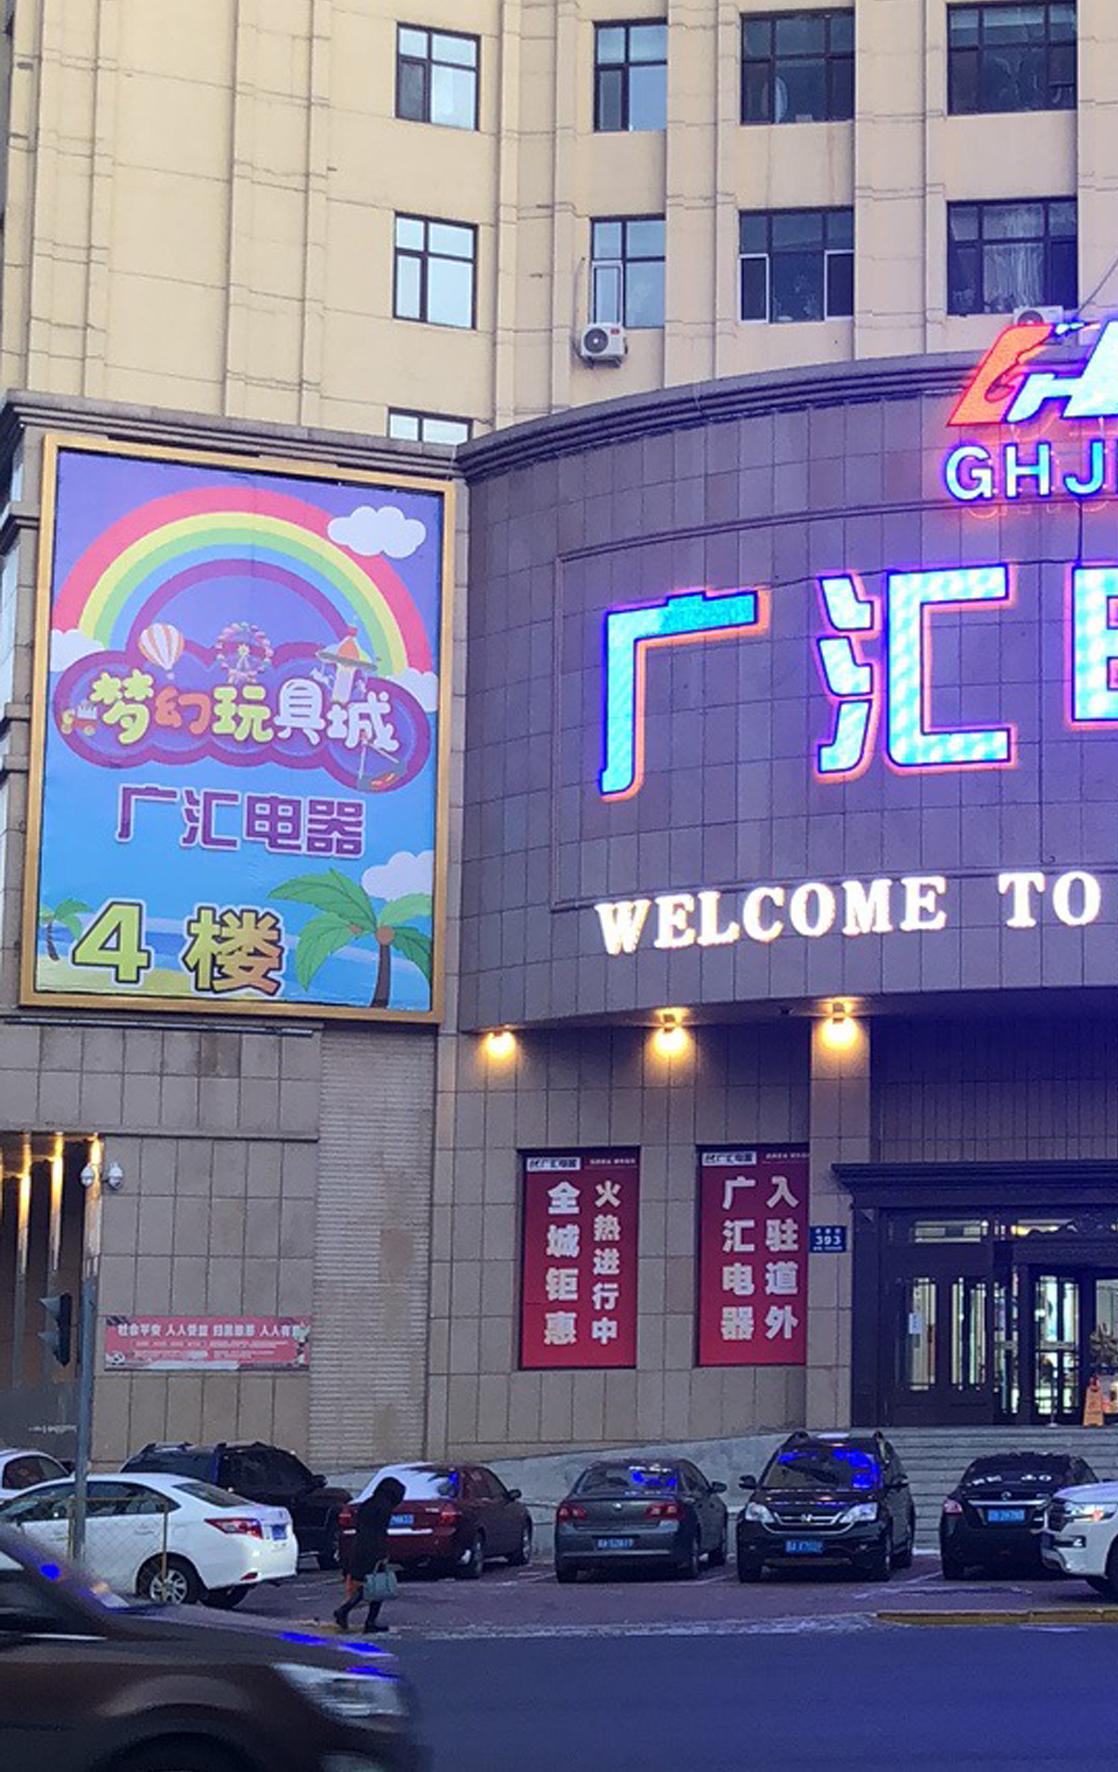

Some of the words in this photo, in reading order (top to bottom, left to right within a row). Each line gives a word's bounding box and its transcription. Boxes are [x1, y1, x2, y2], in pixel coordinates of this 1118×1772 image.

[89, 667, 400, 752] 梦幻玩具城
[116, 784, 367, 859] 广汇电器
[594, 873, 947, 956] WELCOME
[998, 869, 1102, 931] TO
[543, 1181, 581, 1346] 全城钜惠
[591, 1180, 621, 1345] 火热进行中
[720, 1176, 756, 1341] 广汇电器
[764, 1176, 800, 1340] 入驻道外
[815, 1235, 842, 1245] 393
